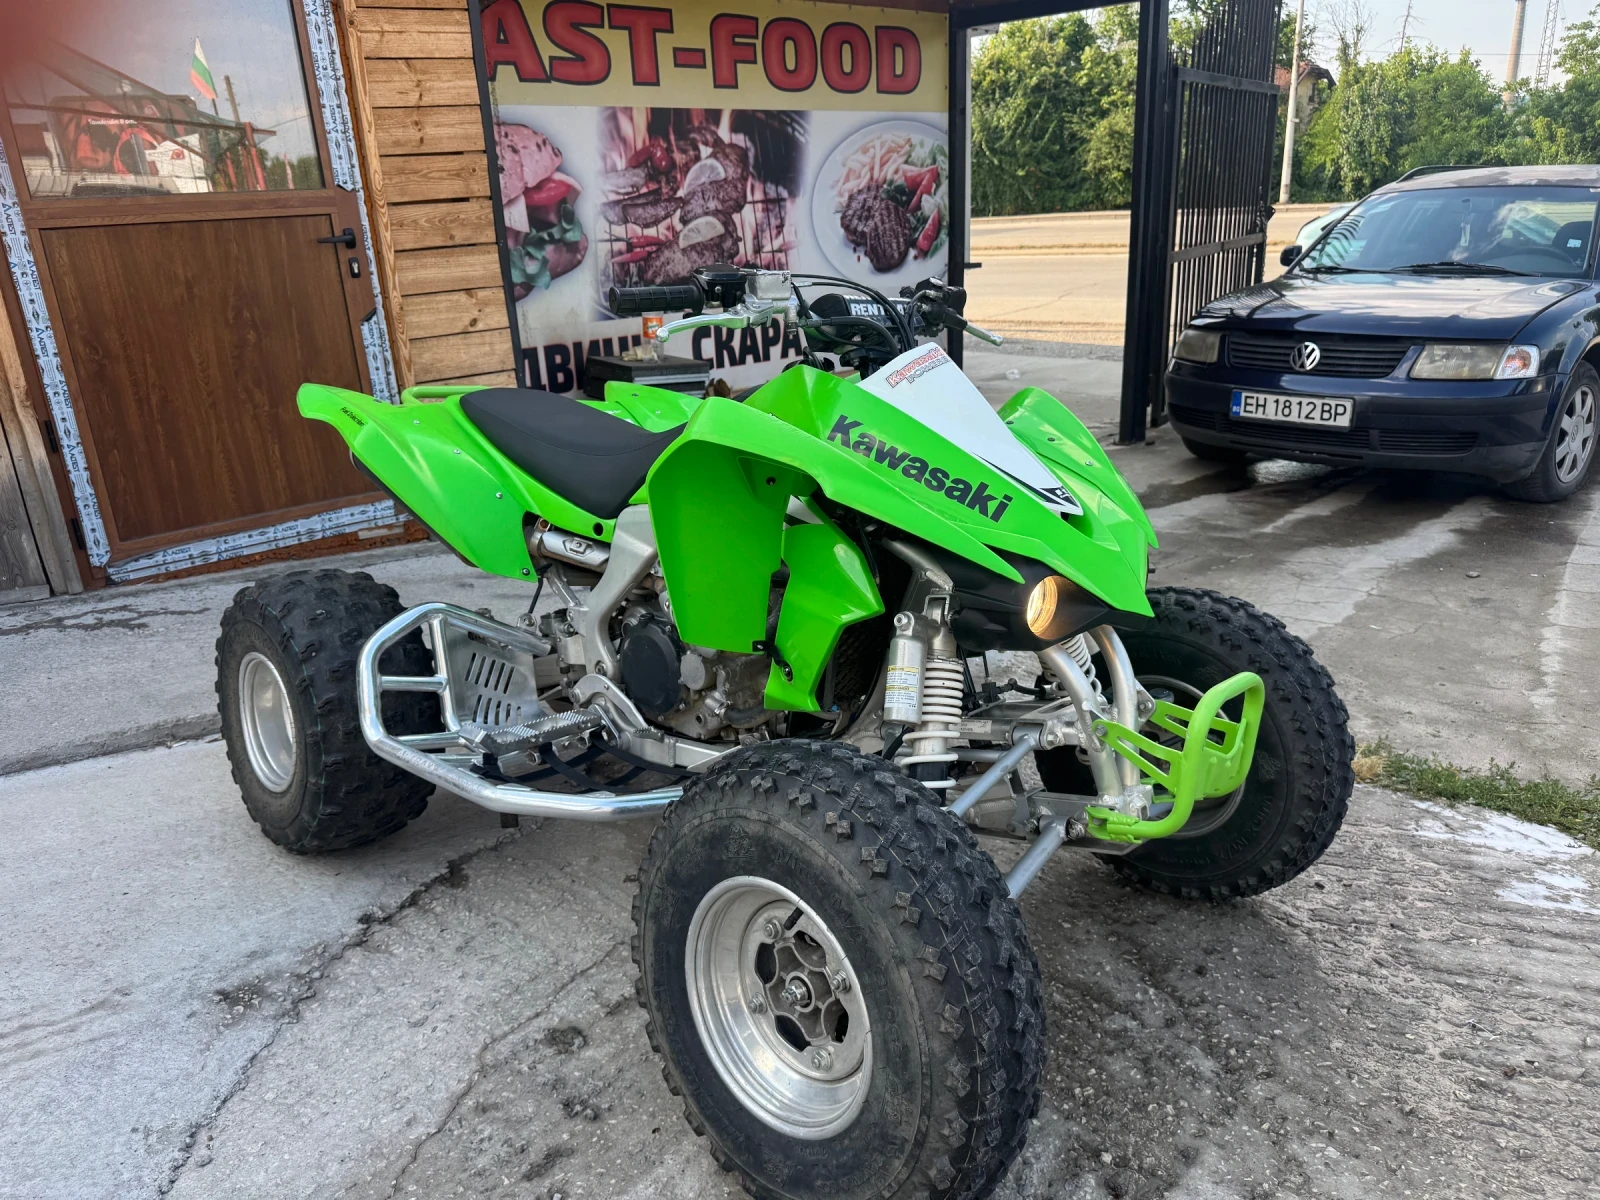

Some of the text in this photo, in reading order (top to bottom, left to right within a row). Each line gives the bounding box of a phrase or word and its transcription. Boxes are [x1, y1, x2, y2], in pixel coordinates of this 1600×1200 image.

[481, 0, 922, 94] AST-FOOD
[850, 303, 907, 316] RENTA
[691, 317, 804, 370] СКАРА
[1273, 398, 1317, 420] 1812
[827, 415, 1013, 523] Kawasaki
